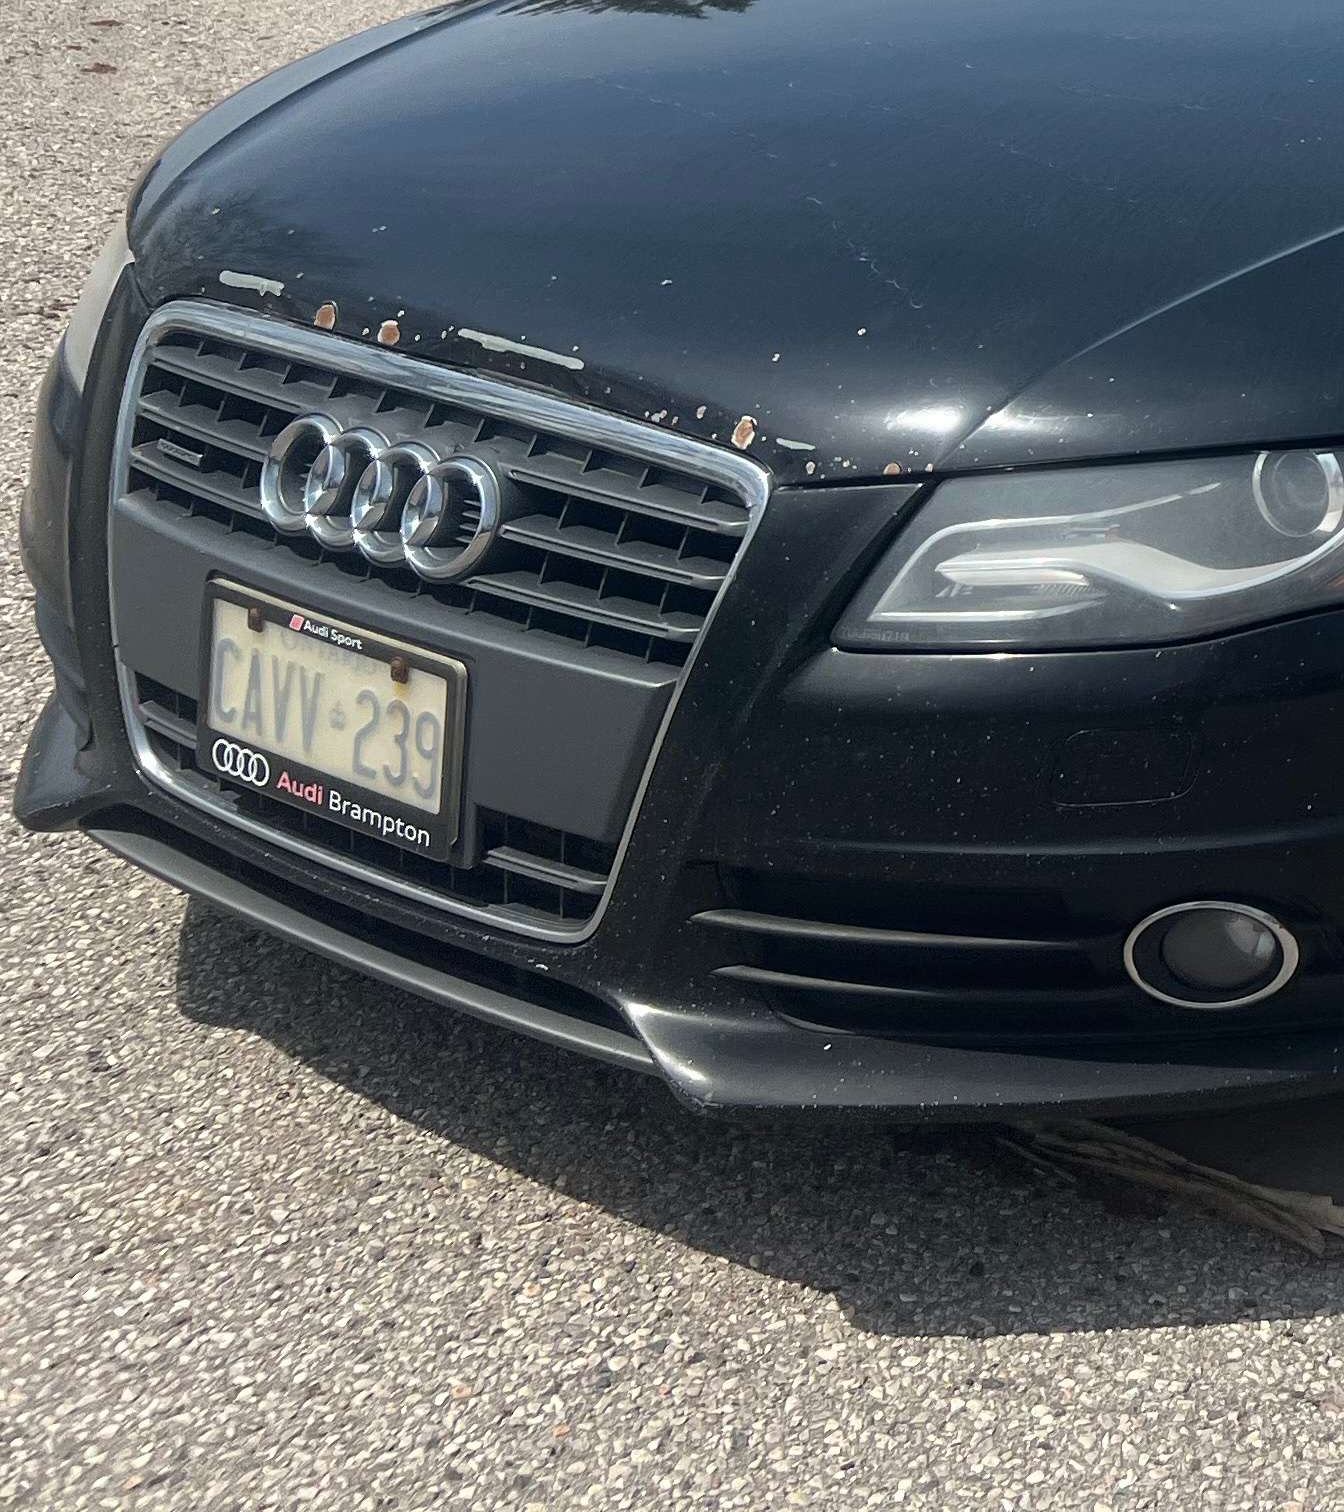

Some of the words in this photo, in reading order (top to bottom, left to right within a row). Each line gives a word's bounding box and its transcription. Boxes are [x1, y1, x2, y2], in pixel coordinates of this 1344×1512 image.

[303, 619, 329, 637] Audi
[330, 630, 363, 650] Sport
[352, 688, 441, 799] 239
[276, 771, 323, 805] Audi
[328, 790, 431, 846] Brampton
